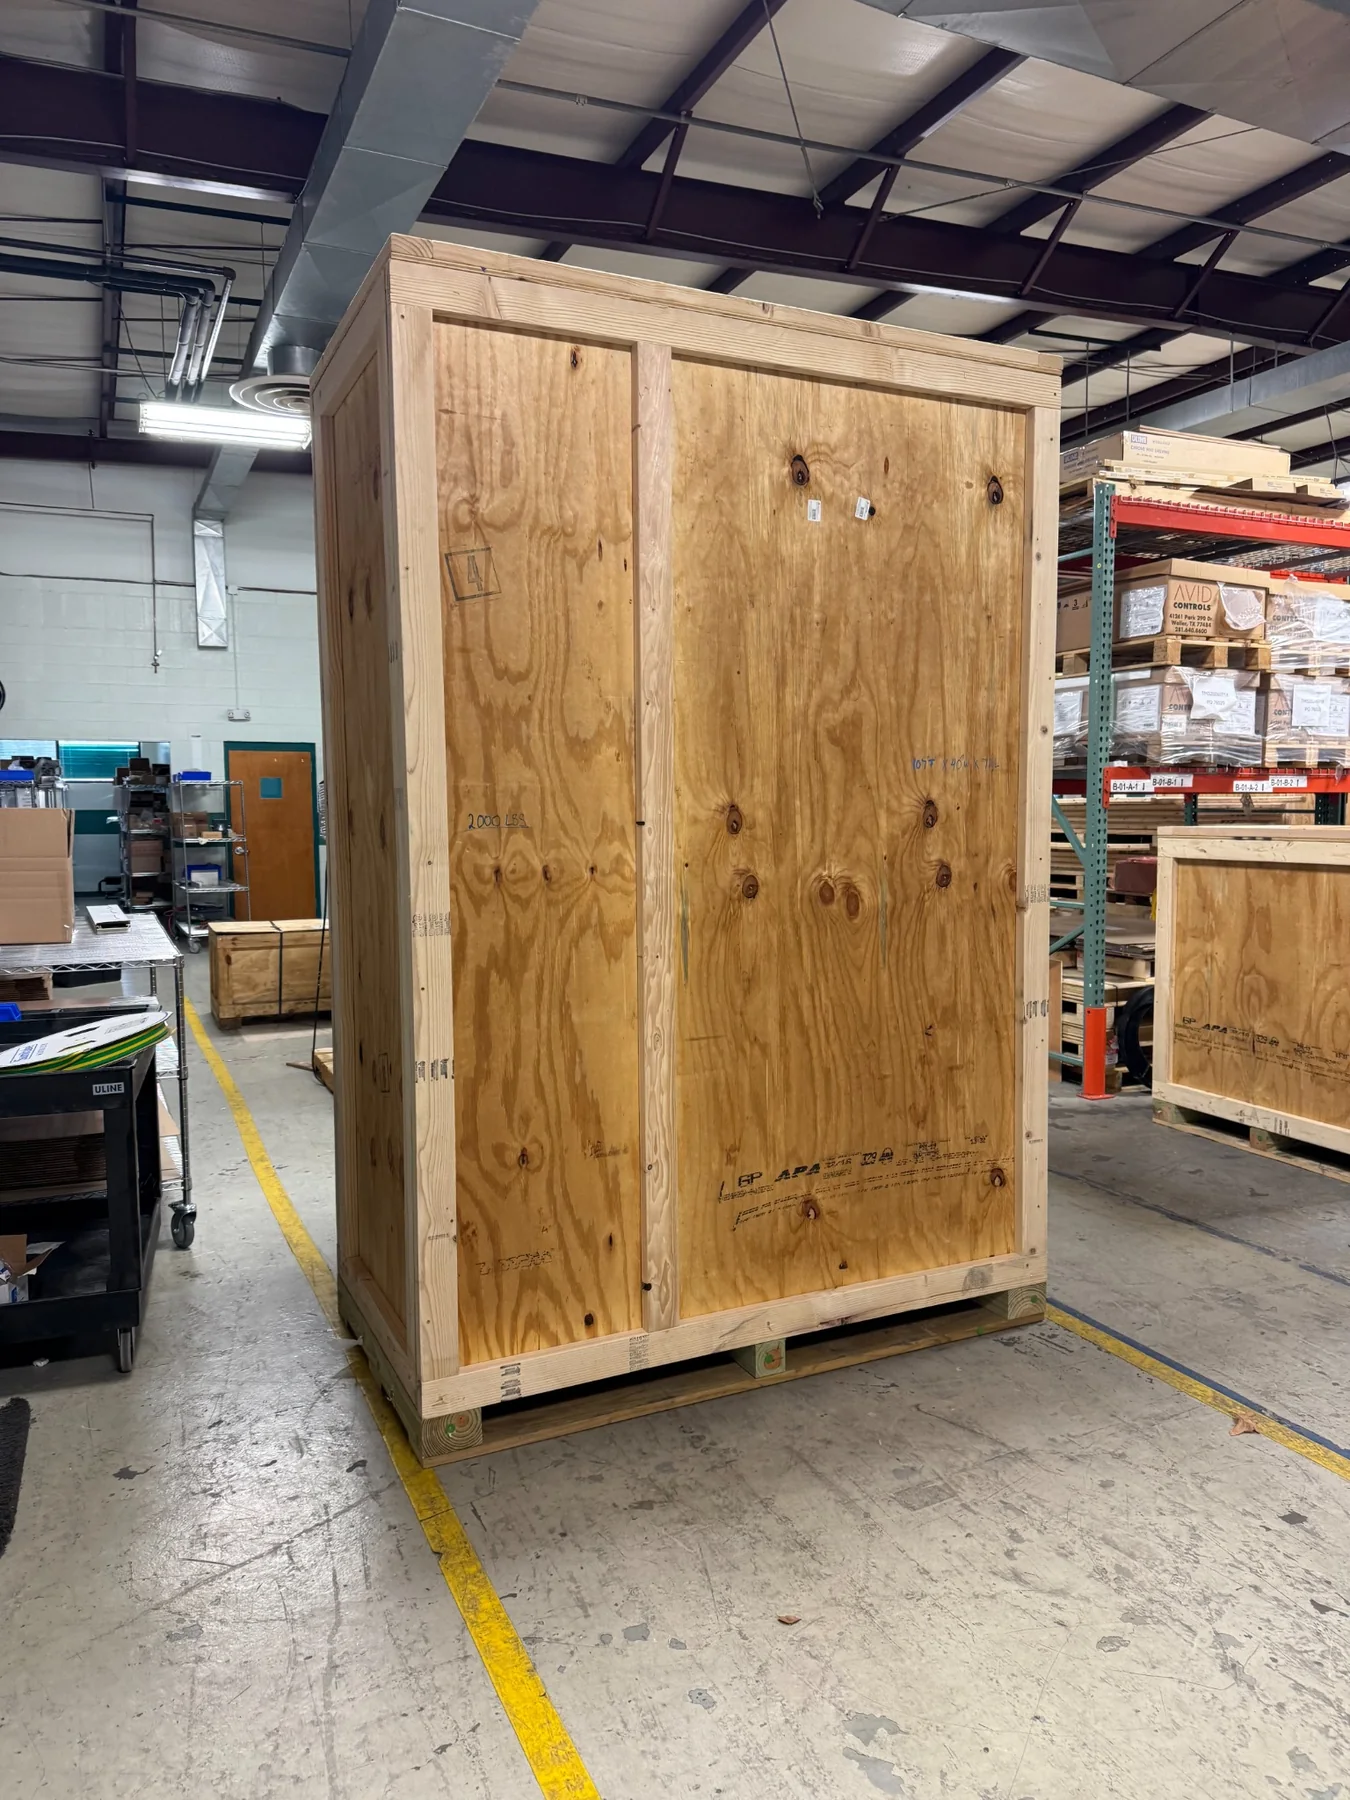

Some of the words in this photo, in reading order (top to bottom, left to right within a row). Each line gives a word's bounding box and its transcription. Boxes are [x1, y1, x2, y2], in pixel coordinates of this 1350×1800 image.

[467, 555, 483, 591] 4
[1174, 584, 1213, 603] AVID
[1173, 601, 1212, 611] CONTROLS
[1112, 782, 1139, 791] B-01-A-1
[1235, 783, 1259, 791] B-01-A-2
[468, 813, 500, 829] 2000
[1202, 1023, 1228, 1034] APA
[94, 1084, 123, 1094] ULINE
[738, 1171, 763, 1188] GP
[774, 1163, 820, 1182] APA
